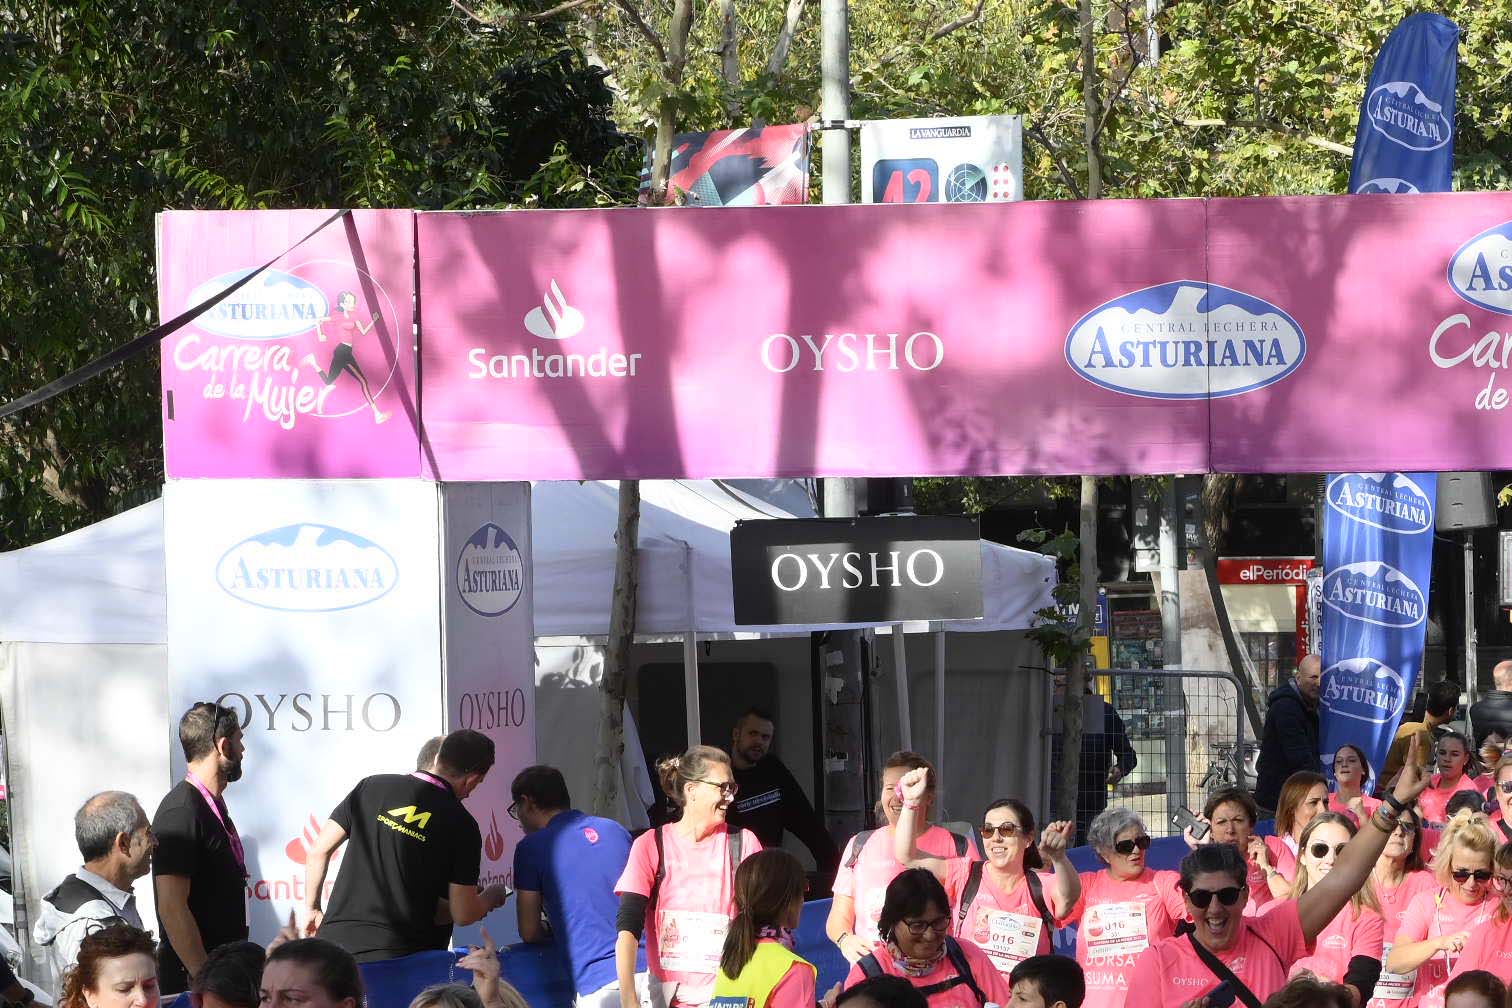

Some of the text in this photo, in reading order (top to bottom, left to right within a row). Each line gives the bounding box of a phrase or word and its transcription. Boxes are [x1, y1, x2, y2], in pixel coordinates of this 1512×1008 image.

[1120, 320, 1281, 333] CENTRAL LECHERA
[173, 333, 290, 371] Carrera
[467, 331, 945, 379] Santander OYSHO
[1084, 325, 1288, 369] ASTURIANA
[203, 369, 337, 430] de la Mujer
[1475, 372, 1509, 411] de
[1336, 481, 1427, 526] ASTURIANA
[230, 557, 385, 590] ASTURIANA
[462, 558, 519, 593] ASTURIANA
[770, 548, 945, 592] OYSHO
[1329, 577, 1420, 619] ASTURIANA
[212, 692, 402, 732] OYSHO
[459, 688, 525, 730] OYSHO
[992, 932, 1015, 945] 016
[1086, 971, 1126, 986] SUMA
